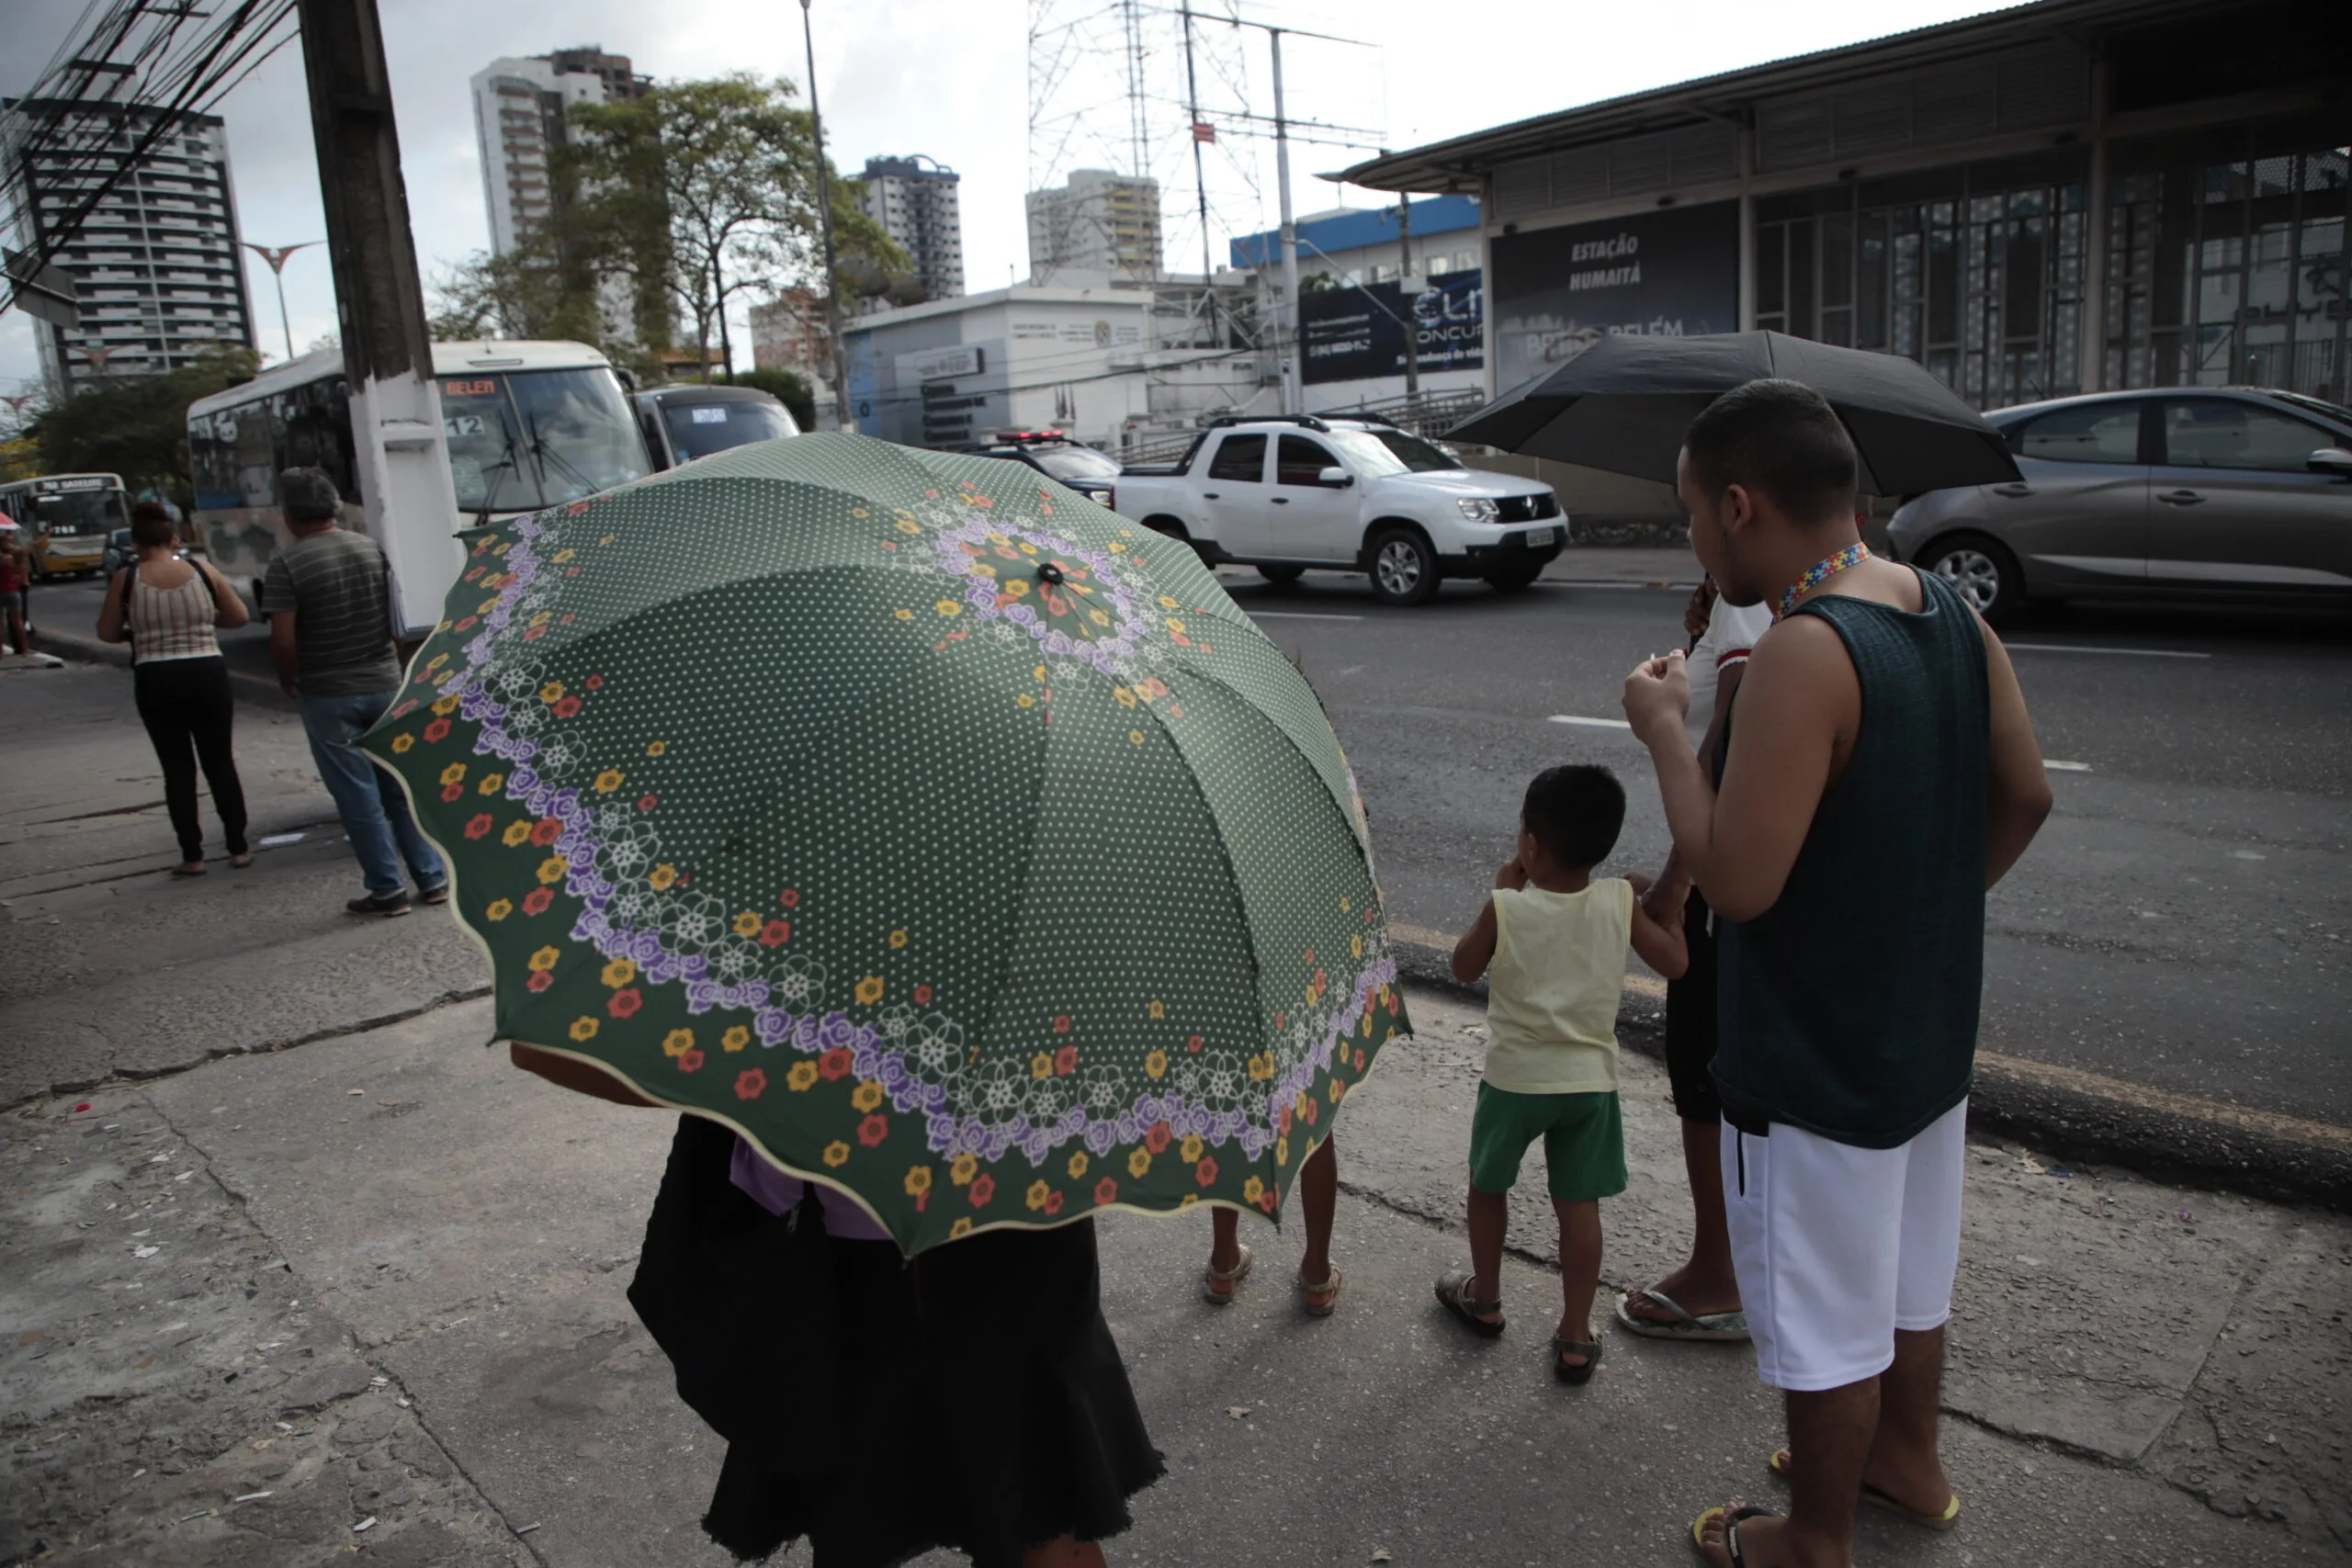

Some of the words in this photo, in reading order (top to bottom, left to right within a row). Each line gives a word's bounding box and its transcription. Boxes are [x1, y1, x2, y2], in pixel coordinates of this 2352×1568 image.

[1571, 232, 1637, 262] ESTAÇÃO
[1569, 261, 1641, 291] HUMAITÁ
[1416, 323, 1483, 344] ONCU
